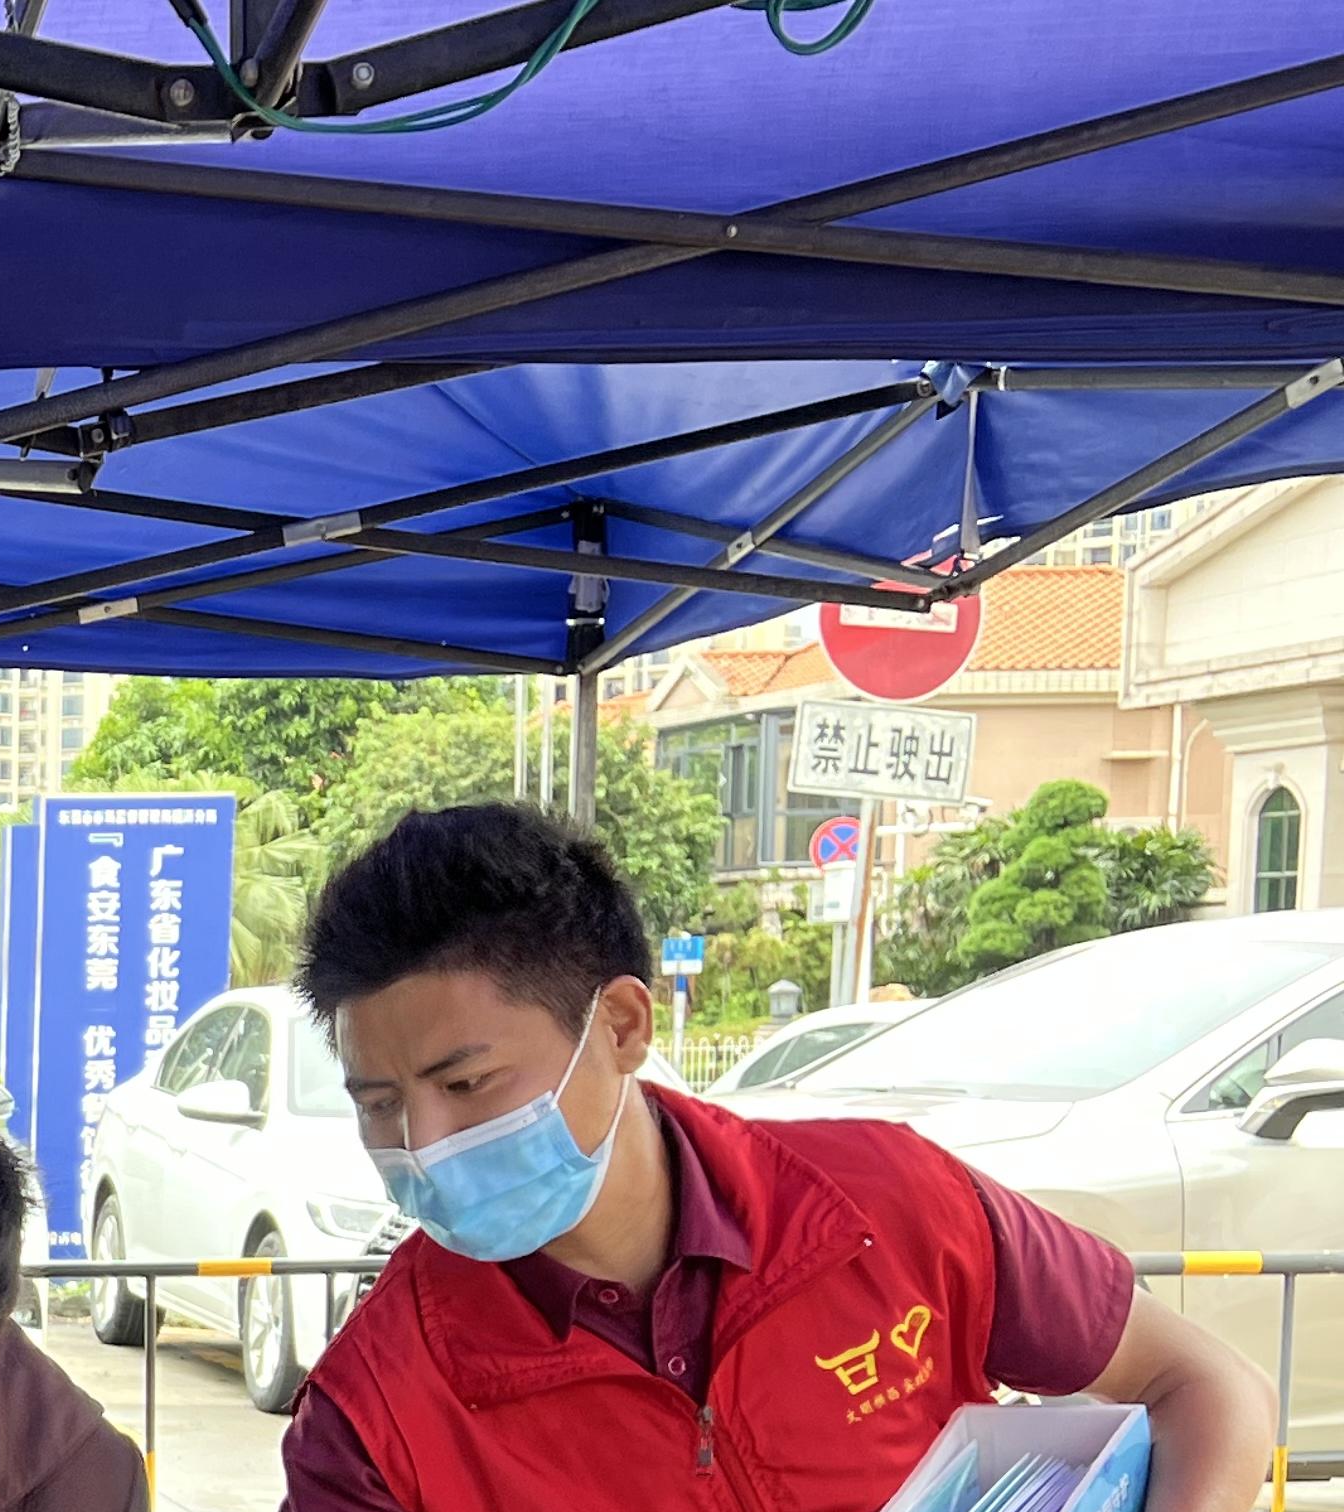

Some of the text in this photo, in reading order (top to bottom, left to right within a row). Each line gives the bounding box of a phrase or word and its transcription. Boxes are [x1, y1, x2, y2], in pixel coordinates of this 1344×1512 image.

[811, 715, 956, 785] 禁止驶出
[143, 843, 185, 1067] 广东省化妆品
